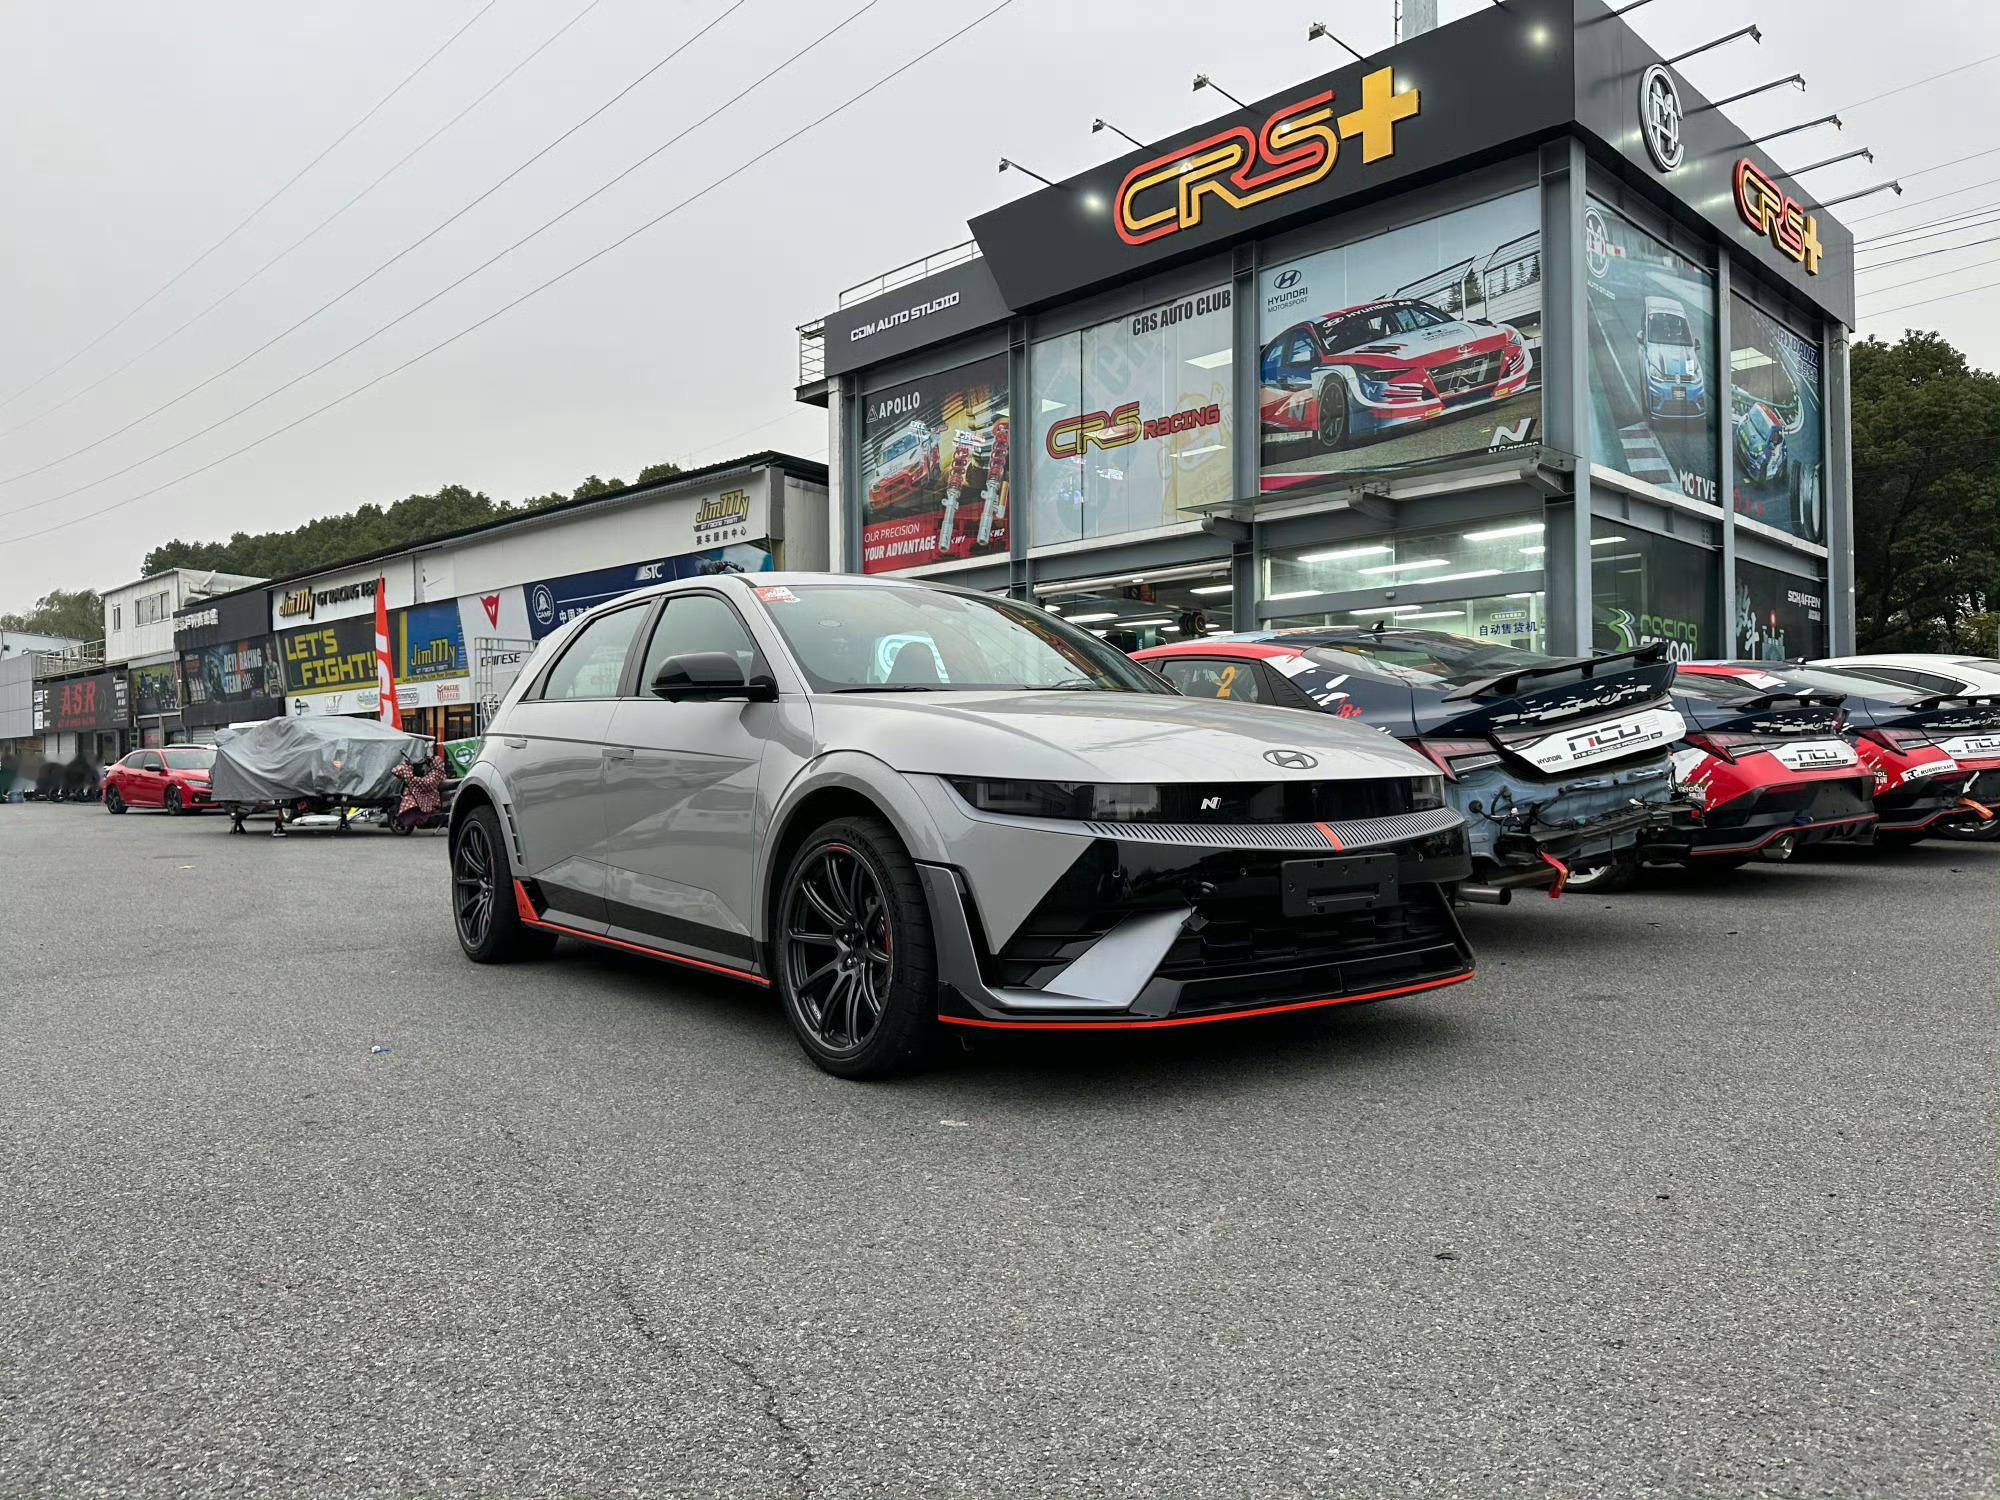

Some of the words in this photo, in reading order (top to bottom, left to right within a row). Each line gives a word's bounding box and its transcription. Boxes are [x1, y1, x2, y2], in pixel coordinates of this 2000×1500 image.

[1267, 286, 1309, 306] HYUNDAI
[1267, 296, 1309, 313] MOTORSPORT
[876, 310, 909, 332] AUTO
[910, 291, 960, 320] STUDIO
[1132, 312, 1158, 336] CRS
[1160, 301, 1193, 328] AUTO
[1196, 289, 1231, 316] CLUB
[1346, 302, 1395, 318] HYUNDAI
[879, 391, 920, 419] APOLLO
[1046, 400, 1143, 460] CRS
[864, 532, 879, 544] OUR
[879, 522, 920, 540] PRECISION
[864, 543, 884, 561] YOUR
[885, 535, 936, 557] ADVANTAGE
[1787, 589, 1821, 609] SCHAFFEN
[1480, 621, 1538, 637] 自动售货机
[284, 628, 338, 661] LET'S
[301, 650, 378, 686] FIGHT!!
[61, 680, 96, 716] ASR
[1537, 754, 1563, 766] HYUNDAI
